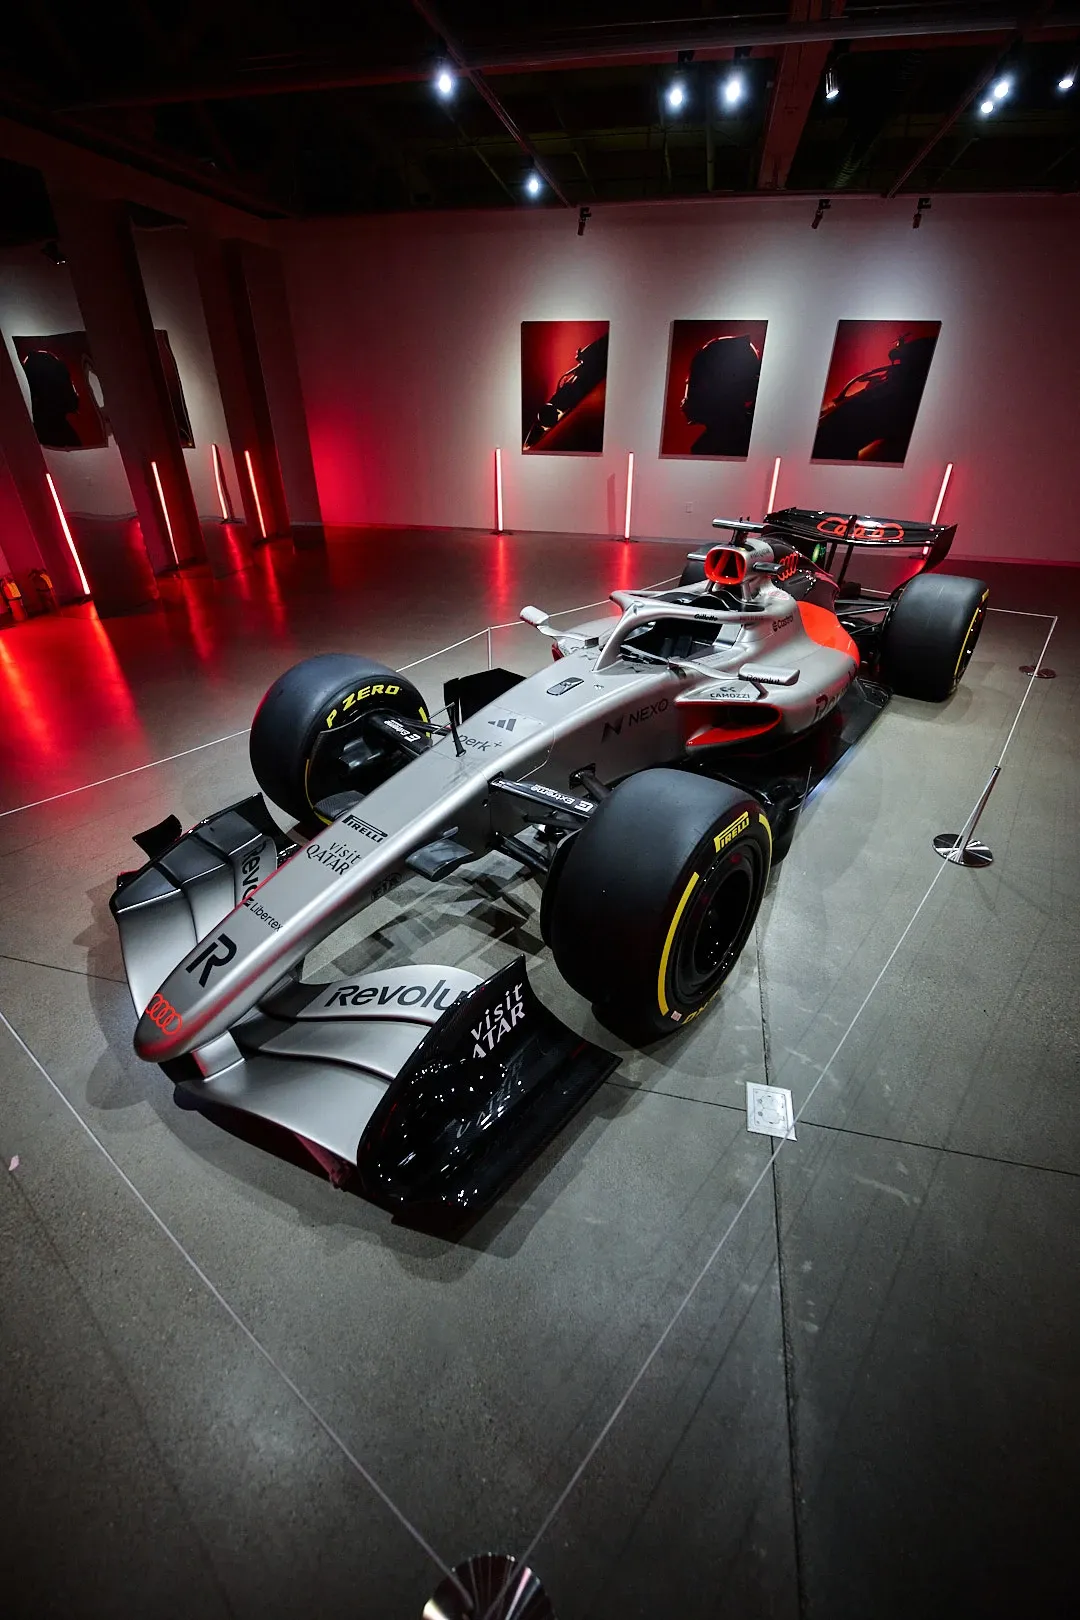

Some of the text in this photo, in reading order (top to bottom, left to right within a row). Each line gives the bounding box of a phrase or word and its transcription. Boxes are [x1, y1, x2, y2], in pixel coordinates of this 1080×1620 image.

[326, 684, 400, 728] P ZERO
[629, 698, 668, 726] NEXO
[341, 814, 389, 843] PIRELLI
[712, 810, 750, 854] PIRELLI
[306, 844, 350, 876] QATAR
[329, 842, 362, 865] visit
[250, 902, 284, 932] Libertex
[471, 982, 523, 1041] visit
[472, 1001, 526, 1059] ATAR
